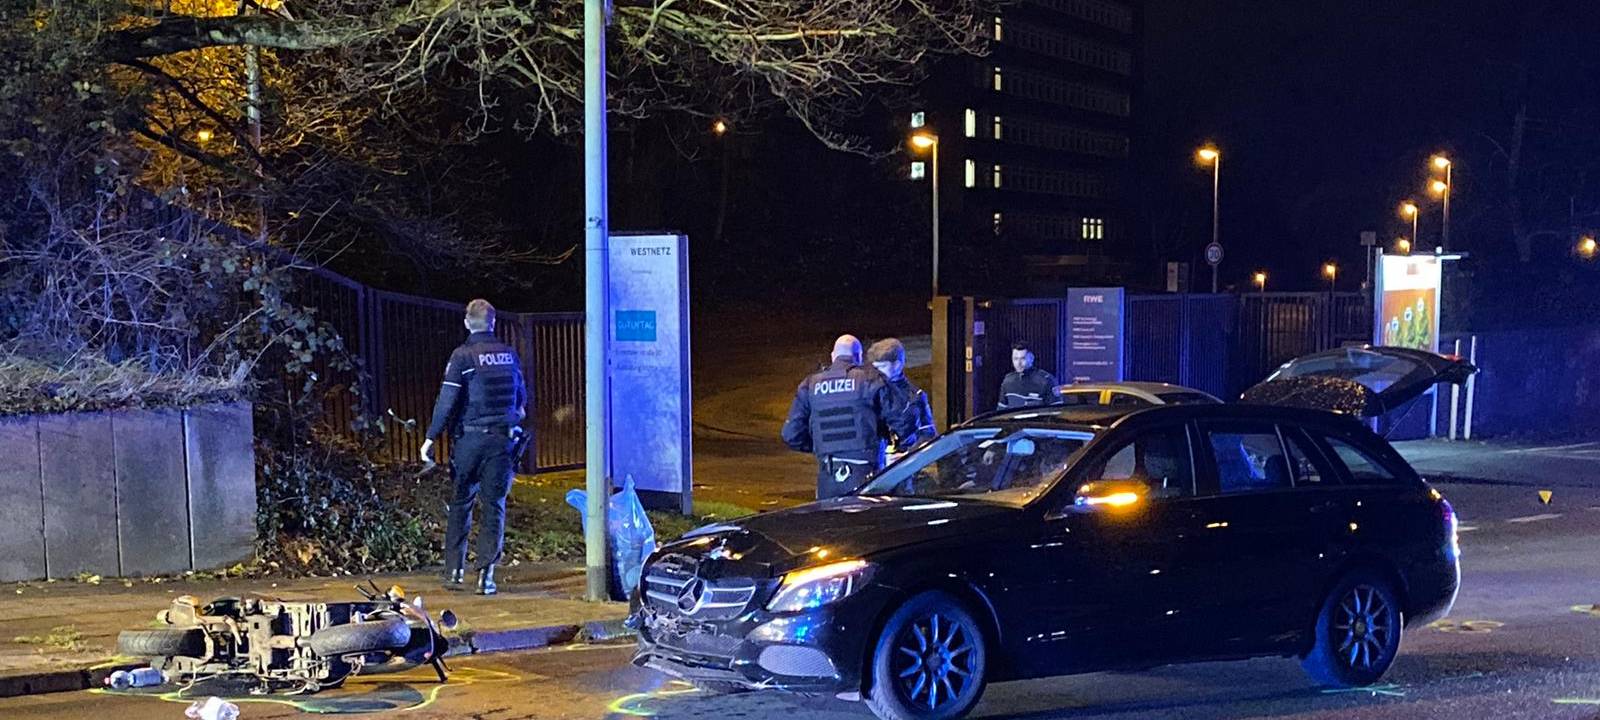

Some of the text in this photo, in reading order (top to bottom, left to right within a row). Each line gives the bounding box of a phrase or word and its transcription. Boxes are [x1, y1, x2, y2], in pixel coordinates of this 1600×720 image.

[630, 247, 671, 256] WESTNETZ
[1083, 295, 1103, 303] RWE
[479, 353, 514, 366] POLIZEI
[814, 379, 855, 395] POLIZEI
